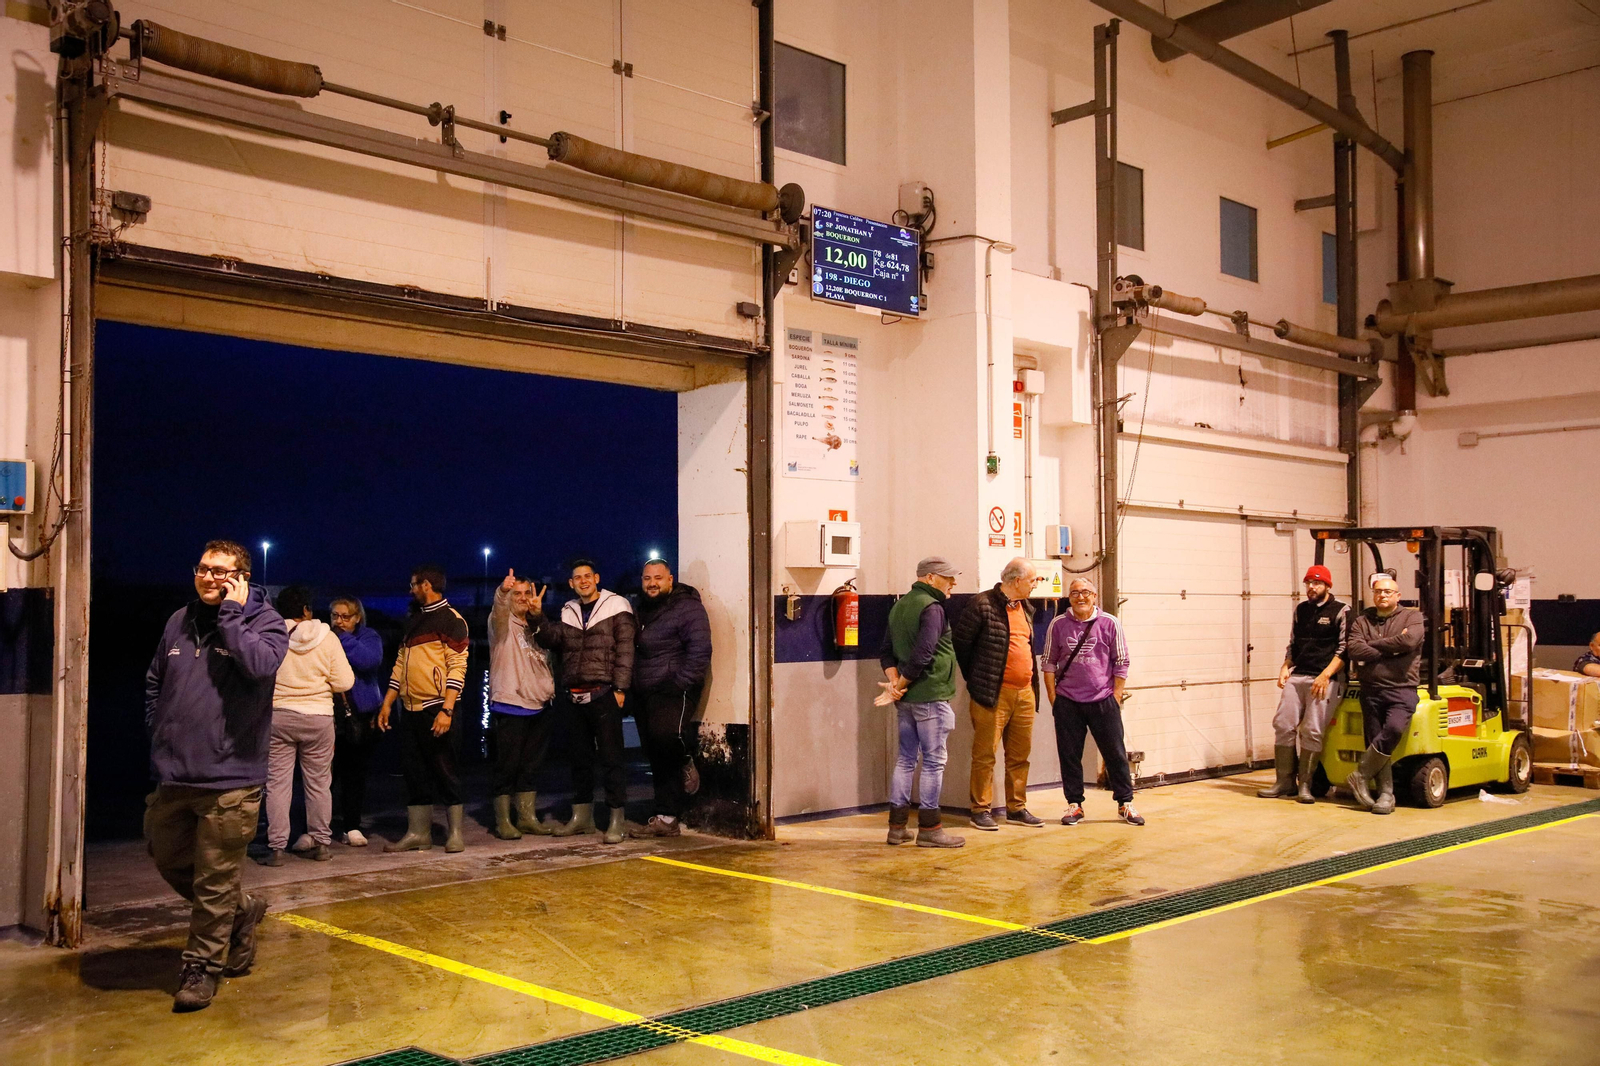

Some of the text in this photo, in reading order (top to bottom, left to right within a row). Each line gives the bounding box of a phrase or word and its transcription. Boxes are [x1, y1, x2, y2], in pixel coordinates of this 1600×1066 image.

[813, 208, 832, 218] 07:20
[835, 224, 867, 236] JONATHAN
[826, 231, 860, 243] BOQUERON
[825, 246, 867, 269] 12,00
[887, 261, 910, 272] 624,78
[874, 268, 890, 279] Caja
[825, 272, 838, 281] 198
[844, 276, 871, 287] DIEGO
[826, 292, 845, 301] PLAYA
[789, 334, 811, 342] ESPECIE
[824, 339, 838, 347] TALLA
[788, 344, 813, 352] BOQUERON
[1472, 747, 1488, 759] CLARK
